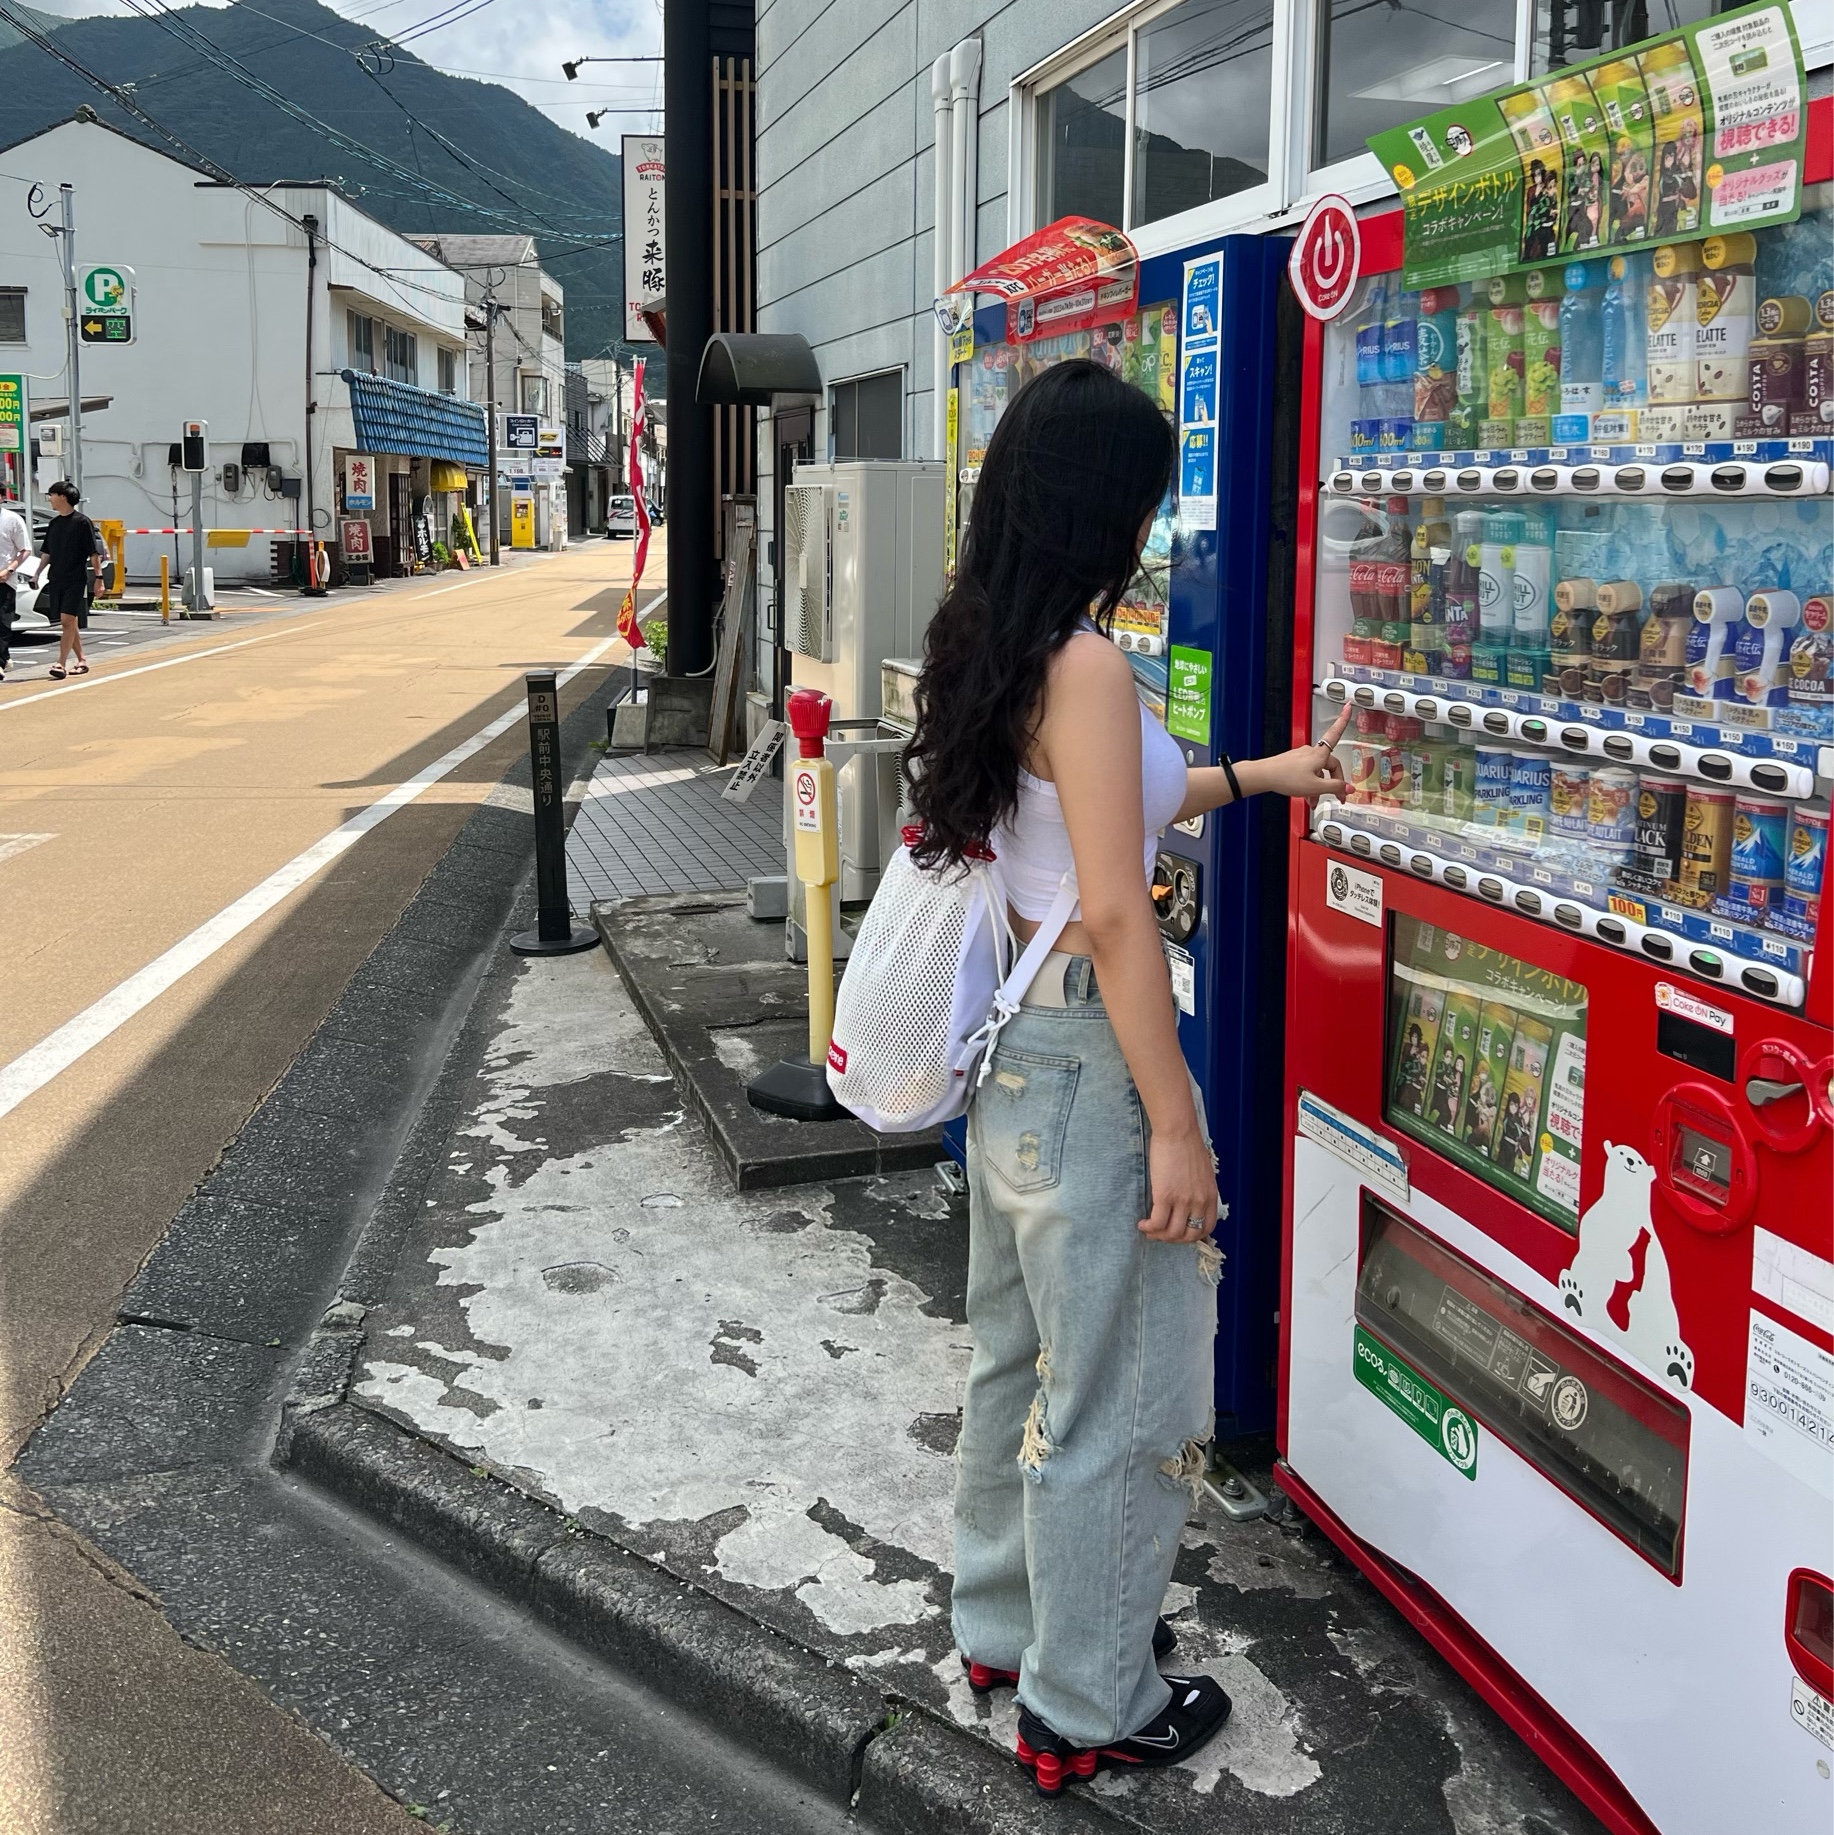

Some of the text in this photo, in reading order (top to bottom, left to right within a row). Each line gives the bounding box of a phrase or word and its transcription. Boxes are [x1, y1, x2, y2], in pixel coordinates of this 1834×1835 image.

[1720, 96, 1796, 125] オリジナルコンテンツが
[1720, 114, 1795, 151] 視聴できる!
[638, 163, 665, 172] TONKATS
[1722, 170, 1788, 191] オリジナルグッズが
[1417, 171, 1519, 216] デザインボトル
[1422, 204, 1504, 235] コラボキャンペーン!
[642, 187, 666, 292] とんかつ 来豚
[94, 274, 119, 301] P
[1003, 281, 1025, 294] KFC
[1193, 273, 1214, 289] チェック!
[1189, 364, 1212, 378] スキャン!
[1752, 364, 1761, 412] COSTA
[1809, 358, 1819, 408] COSTA
[1742, 427, 1781, 436] ミルクの甘み
[1638, 446, 1654, 454] ¥170
[1686, 445, 1702, 453] ¥170
[1736, 444, 1755, 452] ¥190
[1791, 441, 1811, 449] ¥190
[352, 462, 367, 493] 焼肉
[349, 524, 363, 551] 焼肉
[1174, 659, 1207, 674] 地球にやさしい
[1468, 689, 1481, 698] ¥210
[1795, 679, 1826, 692] COCOA
[1503, 694, 1516, 702] ¥210
[1543, 701, 1557, 710] ¥140
[1173, 703, 1205, 720] ヒートポンプ
[1584, 708, 1599, 718] ¥140
[1626, 716, 1642, 725] ¥150
[1673, 724, 1691, 734] ¥150
[1722, 732, 1740, 742] ¥150
[1774, 741, 1794, 751] ¥160
[747, 731, 784, 783] 関係者以外
[538, 728, 552, 806] 駅前中央通り
[730, 750, 760, 791] 立入禁止
[1355, 883, 1374, 897] iPhoneで
[1350, 890, 1380, 908] タッチレス体験!
[1611, 897, 1644, 919] 100円
[1664, 910, 1681, 920] ¥110
[1713, 927, 1731, 938] ¥110
[1765, 943, 1784, 955] ¥110
[1485, 968, 1567, 1014] コラボキャンペーン!
[1673, 997, 1726, 1027] Coke ON Pay
[1551, 1102, 1583, 1121] オリジナルコン
[1550, 1112, 1583, 1140] 視聴で
[1545, 1156, 1580, 1179] オリジナルグ
[1543, 1167, 1564, 1185] 当たる!
